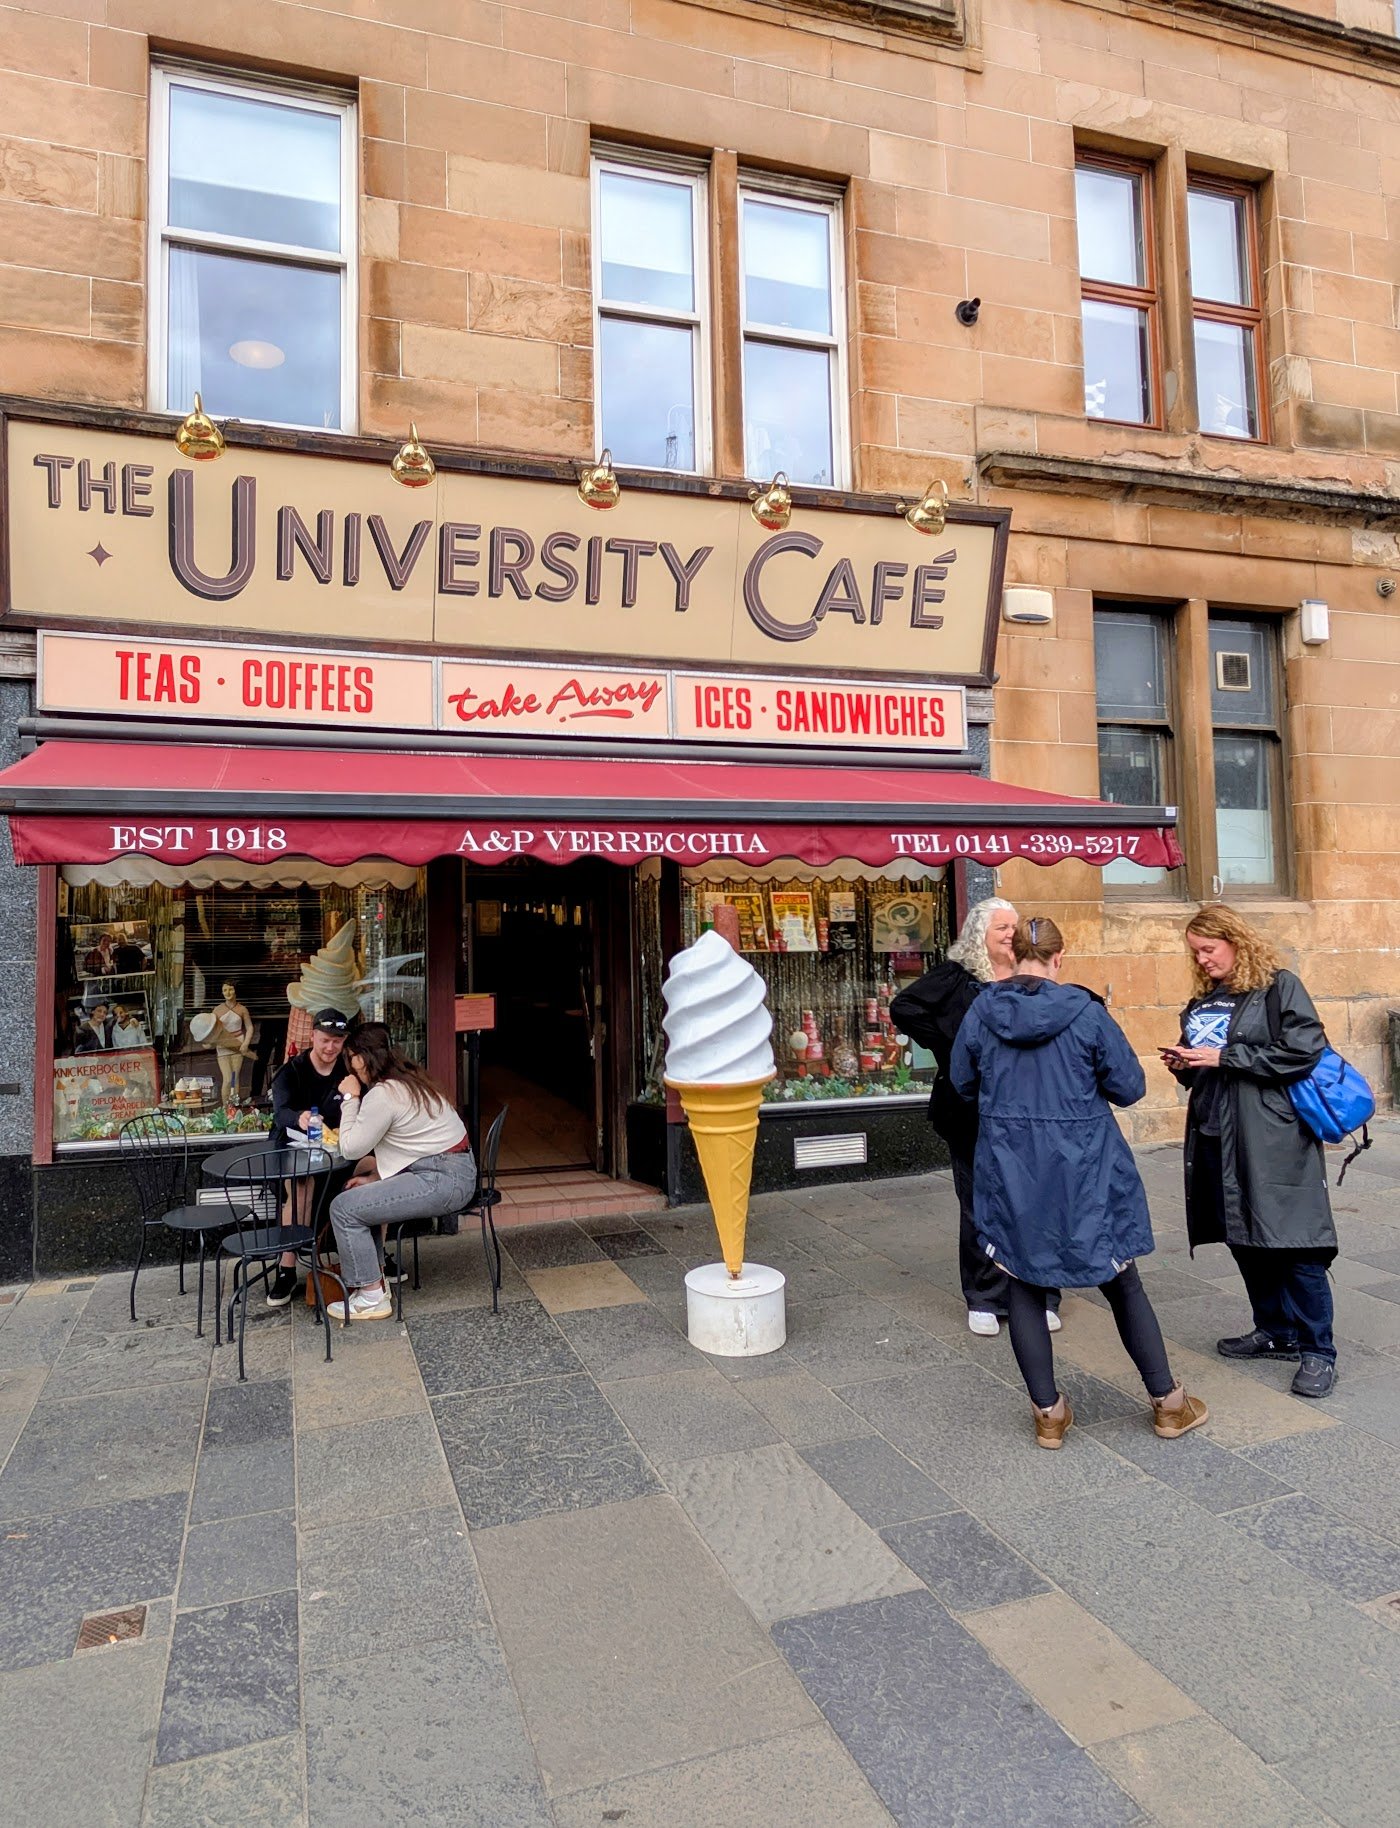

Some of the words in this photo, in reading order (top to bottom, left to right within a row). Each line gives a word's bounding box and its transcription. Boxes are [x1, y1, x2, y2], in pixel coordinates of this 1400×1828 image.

[34, 453, 155, 518] THE
[168, 468, 714, 613] UNIVERSITY
[743, 531, 957, 643] CAFÉ
[116, 651, 201, 704] TEAS
[242, 659, 374, 714] COFFEES
[447, 683, 542, 722] take
[546, 678, 662, 715] Away
[694, 685, 752, 730] ICES
[776, 689, 945, 738] SANDWICHES
[108, 826, 194, 851] EST
[205, 826, 288, 851] 1918
[455, 829, 534, 853] A&P
[543, 830, 769, 854] VERRECCHIA
[891, 833, 950, 855] TEL
[956, 833, 1013, 855] 0141
[53, 1061, 142, 1079] KNICKERBOCKER
[91, 1096, 127, 1107] DIPLOMA
